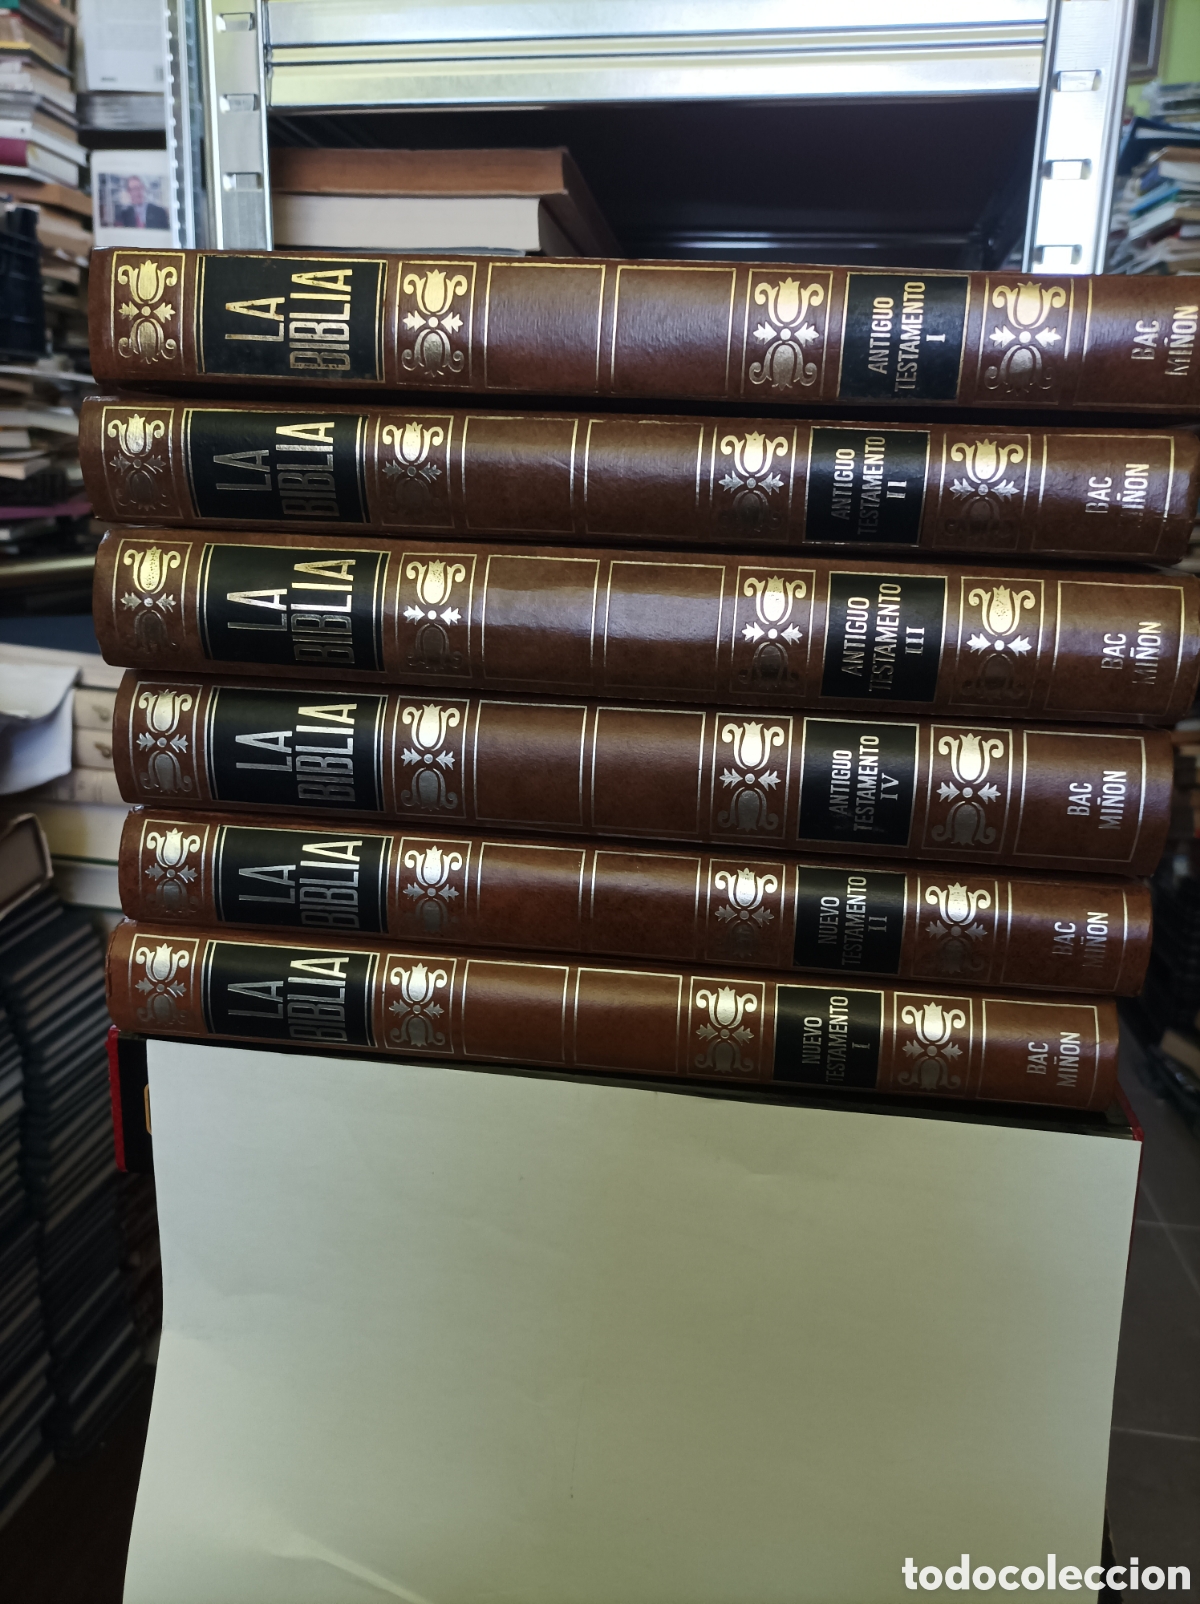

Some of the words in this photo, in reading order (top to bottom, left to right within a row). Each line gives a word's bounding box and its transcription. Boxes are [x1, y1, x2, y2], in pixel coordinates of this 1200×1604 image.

[225, 297, 285, 342] LA
[289, 269, 353, 371] BIBLIA
[868, 297, 894, 375] ANTIGUO
[895, 281, 925, 393] TESTAMENTO
[926, 333, 946, 343] I
[1132, 319, 1160, 361] BAC
[213, 449, 272, 491] LA
[275, 421, 340, 517] BIBLIA
[830, 447, 856, 521] ANTIGUO
[857, 436, 886, 536] TESTAMENTO
[886, 480, 907, 499] II
[1085, 476, 1113, 514] BAC
[1117, 463, 1150, 528] IÑON
[227, 589, 287, 631] LA
[291, 559, 356, 664] BIBLIA
[841, 596, 870, 678] ANTIGUO
[869, 582, 902, 692] TESTAMENTO
[905, 627, 925, 655] III
[1101, 632, 1128, 671] BAC
[235, 730, 293, 772] LA
[295, 703, 358, 802] BIBLIA
[828, 749, 853, 816] ANTIGUO
[853, 735, 880, 832] TESTAMENTO
[880, 773, 899, 801] IV
[1066, 781, 1093, 816] BAC
[238, 864, 296, 904] LA
[299, 840, 363, 929] BIBLIA
[818, 896, 840, 945] NUEVO
[842, 876, 867, 966] TESTAMENTO
[868, 916, 888, 933] II
[1052, 921, 1076, 956] BAC
[228, 980, 284, 1019] LA
[287, 957, 350, 1042] BIBLIA
[801, 1016, 823, 1065] NUEVO
[826, 995, 849, 1083] TESTAMENTO
[852, 1042, 871, 1050] I
[1026, 1041, 1049, 1076] BAC
